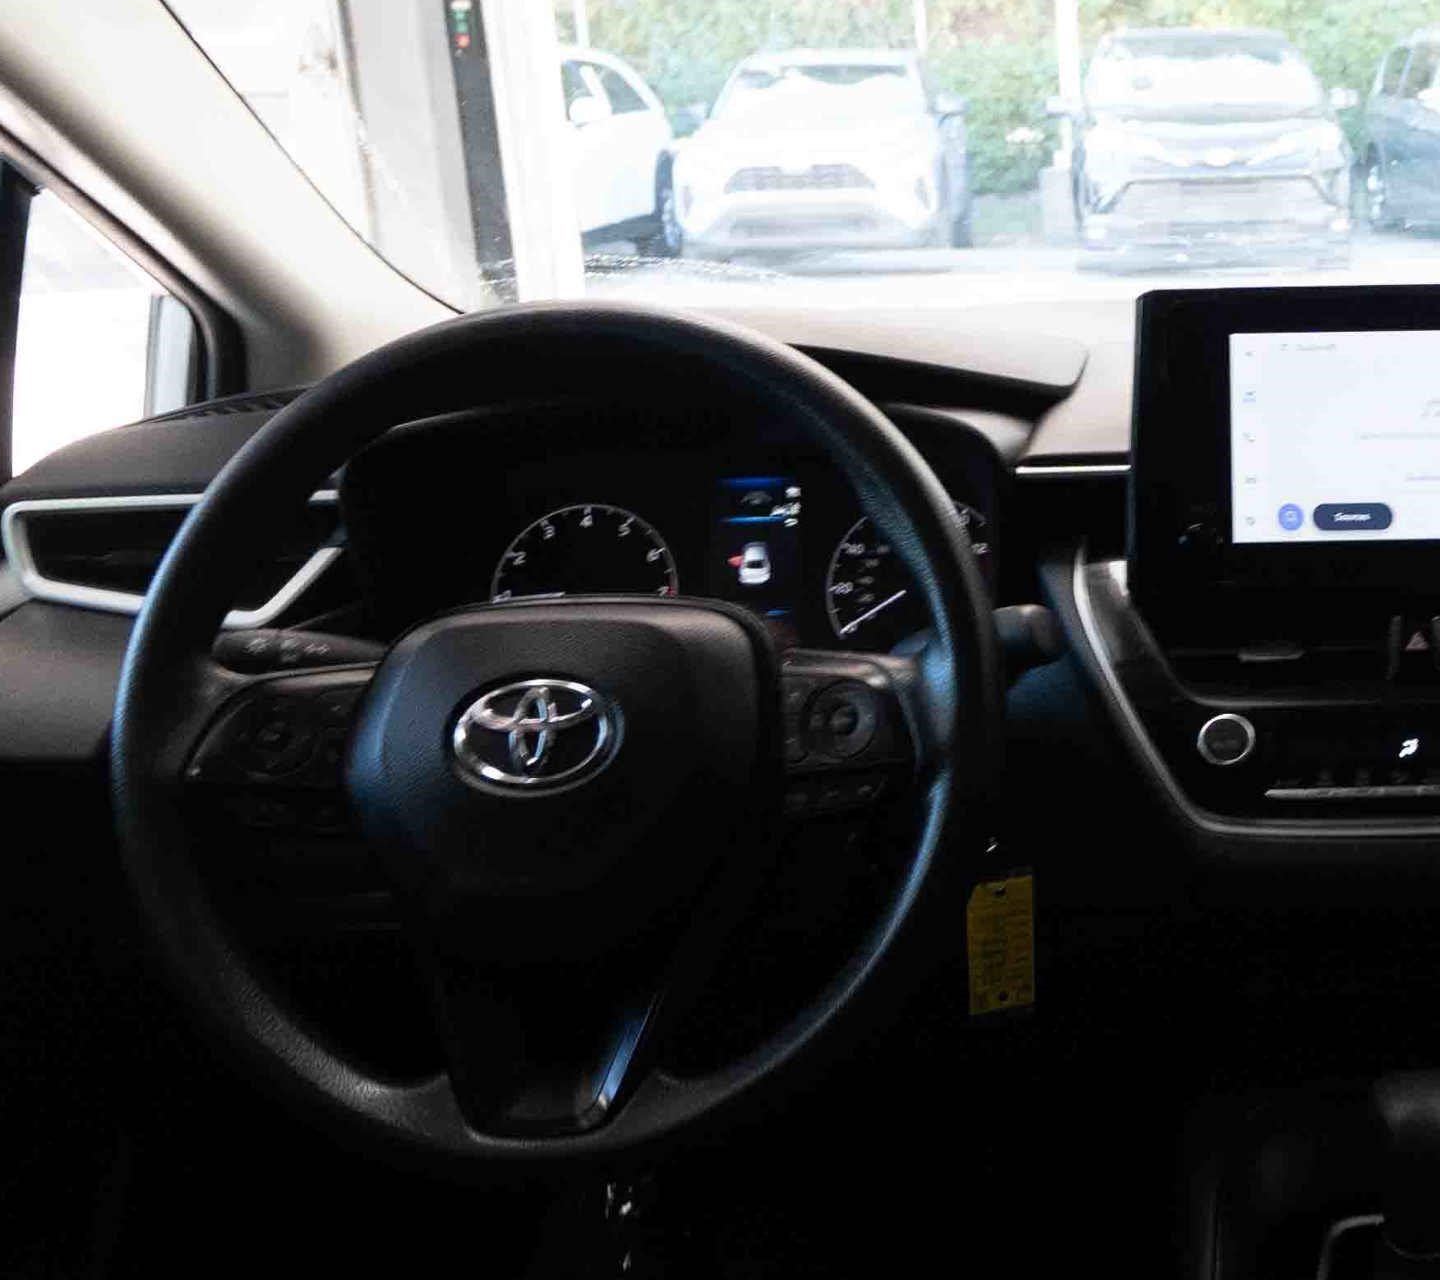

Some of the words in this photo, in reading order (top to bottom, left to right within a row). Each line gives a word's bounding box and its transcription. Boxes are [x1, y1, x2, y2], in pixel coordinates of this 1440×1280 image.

[579, 514, 593, 528] 4
[543, 524, 556, 540] 3
[618, 522, 632, 538] 5
[512, 550, 527, 566] 2
[646, 549, 660, 563] 6
